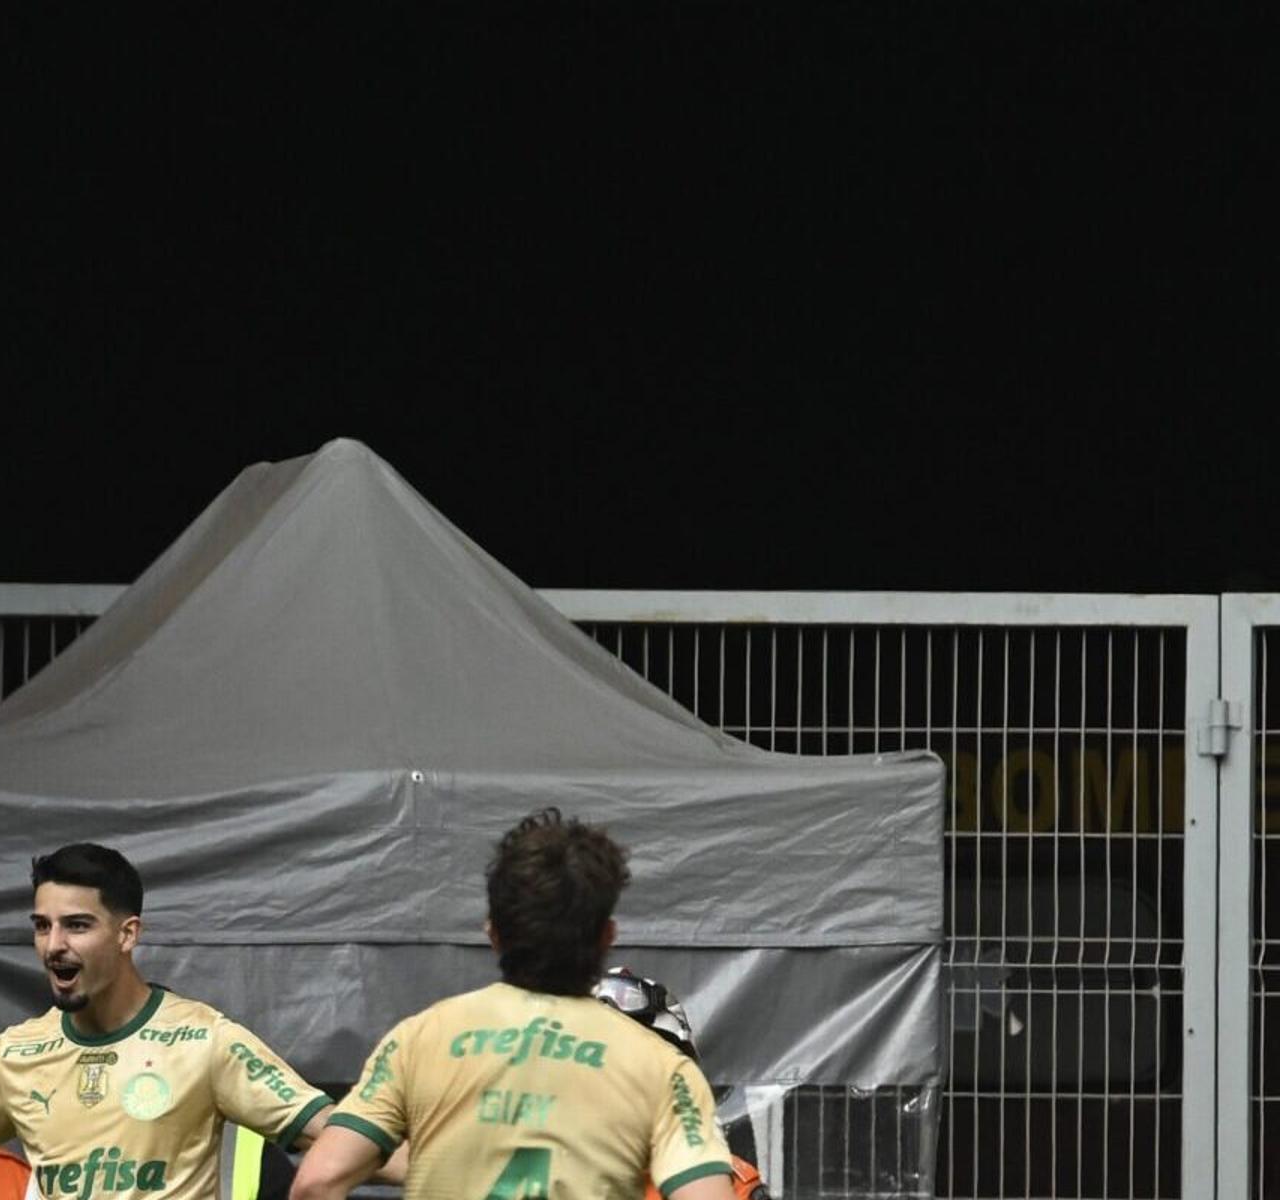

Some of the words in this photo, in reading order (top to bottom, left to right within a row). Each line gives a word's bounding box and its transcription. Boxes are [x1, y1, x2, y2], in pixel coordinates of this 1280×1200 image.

[139, 1026, 208, 1046] crefisa
[449, 1017, 608, 1068] crefisa
[230, 1042, 296, 1102] crefisa
